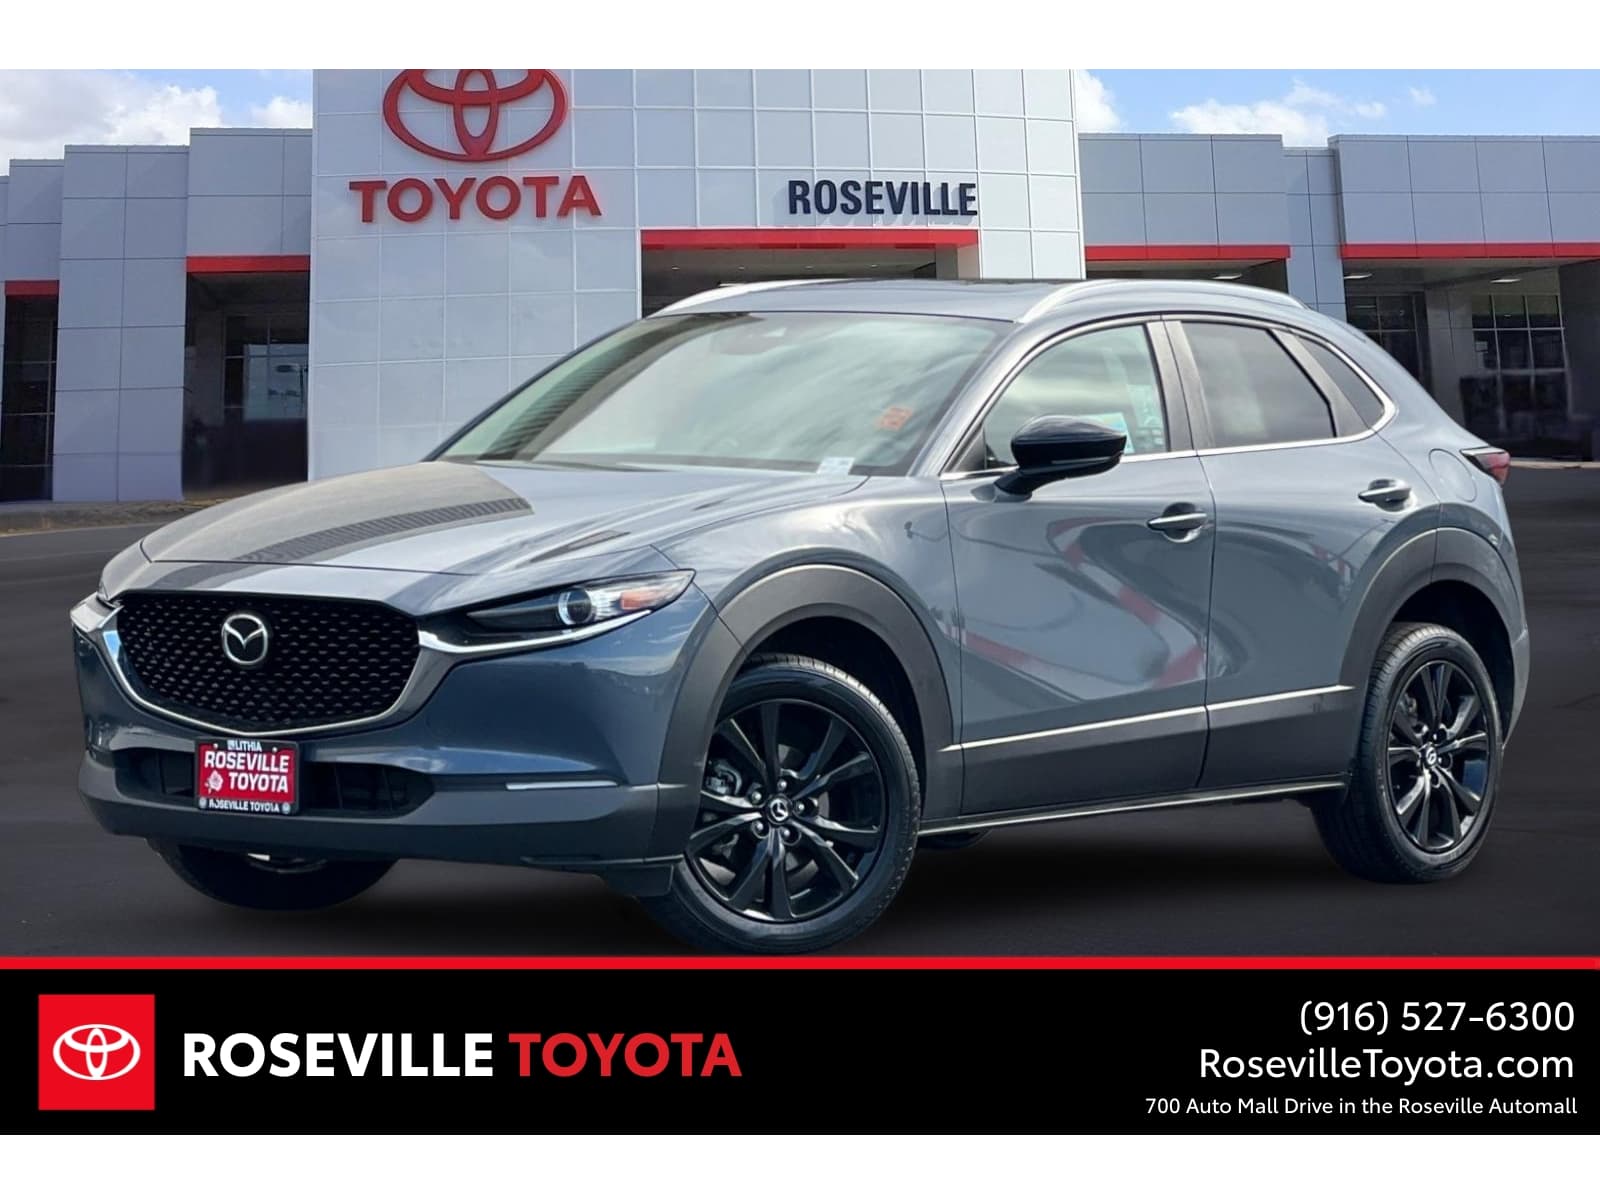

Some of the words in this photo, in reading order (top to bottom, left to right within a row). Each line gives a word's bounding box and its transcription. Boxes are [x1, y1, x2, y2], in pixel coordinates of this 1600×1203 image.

[348, 175, 602, 224] TOYOTA
[788, 179, 978, 216] ROSEVILLE
[235, 739, 263, 753] LITHIA
[204, 751, 290, 773] ROSEVILLE
[228, 771, 289, 793] TOYOTA
